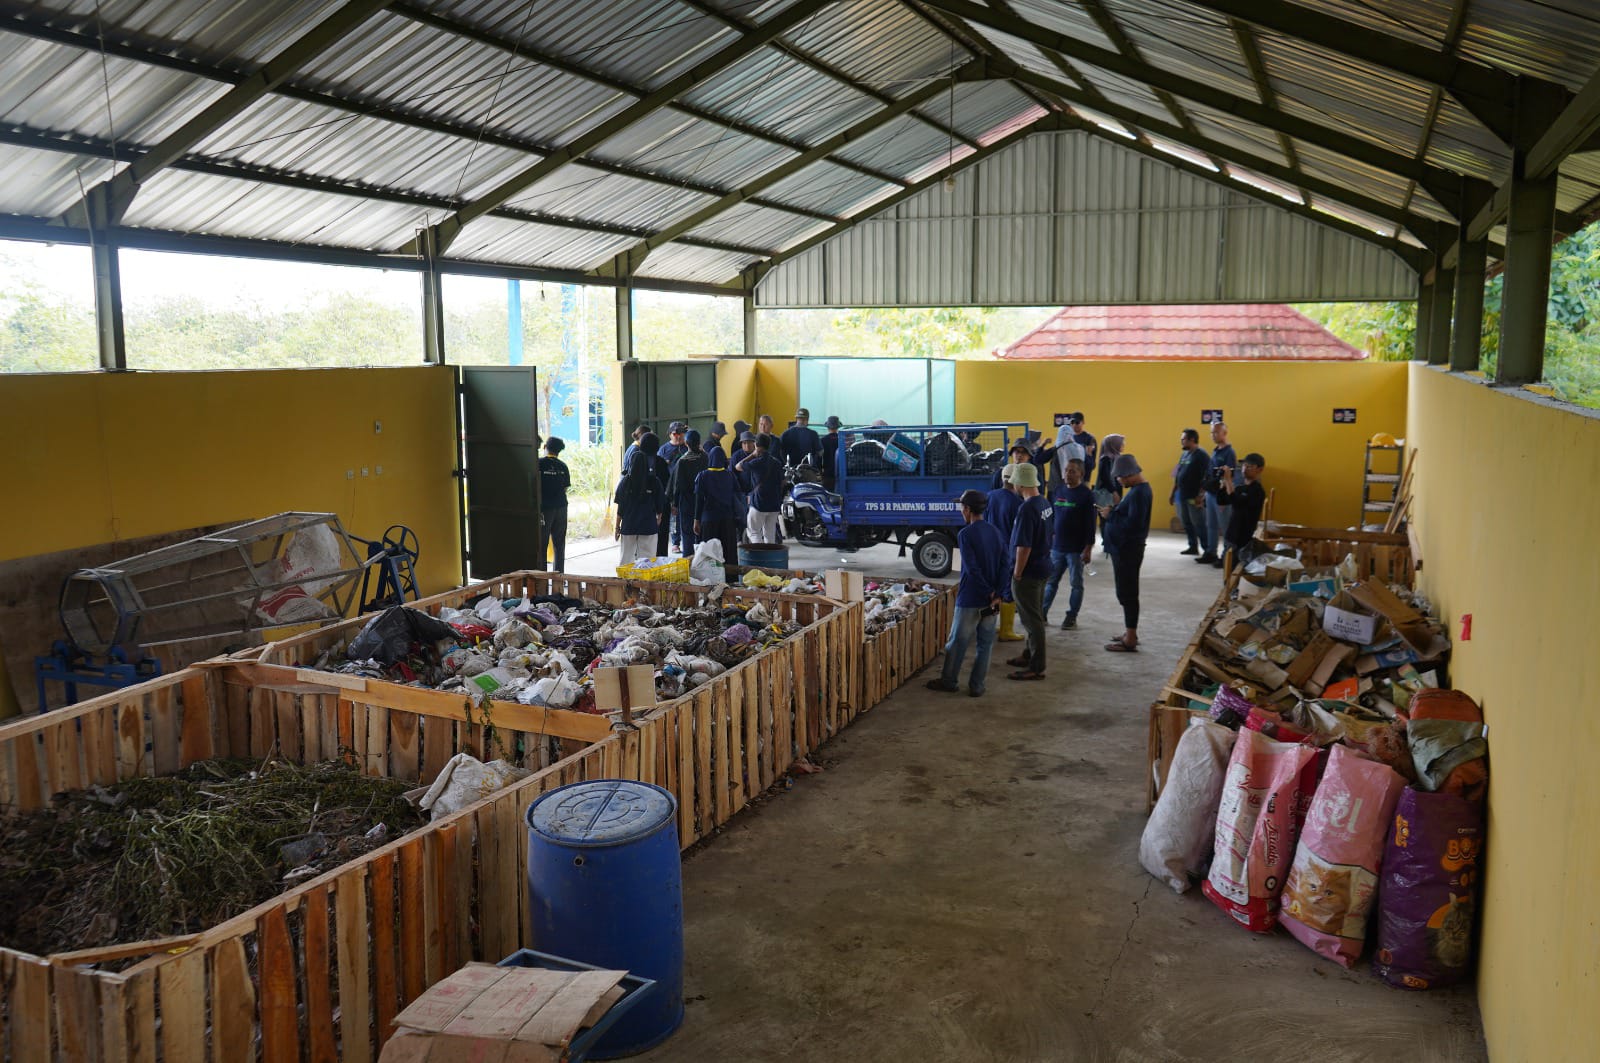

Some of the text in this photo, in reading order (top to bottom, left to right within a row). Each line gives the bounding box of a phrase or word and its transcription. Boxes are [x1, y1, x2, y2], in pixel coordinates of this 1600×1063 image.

[865, 502, 879, 511] TPS
[886, 502, 892, 511] R
[893, 502, 926, 511] PAMPANG
